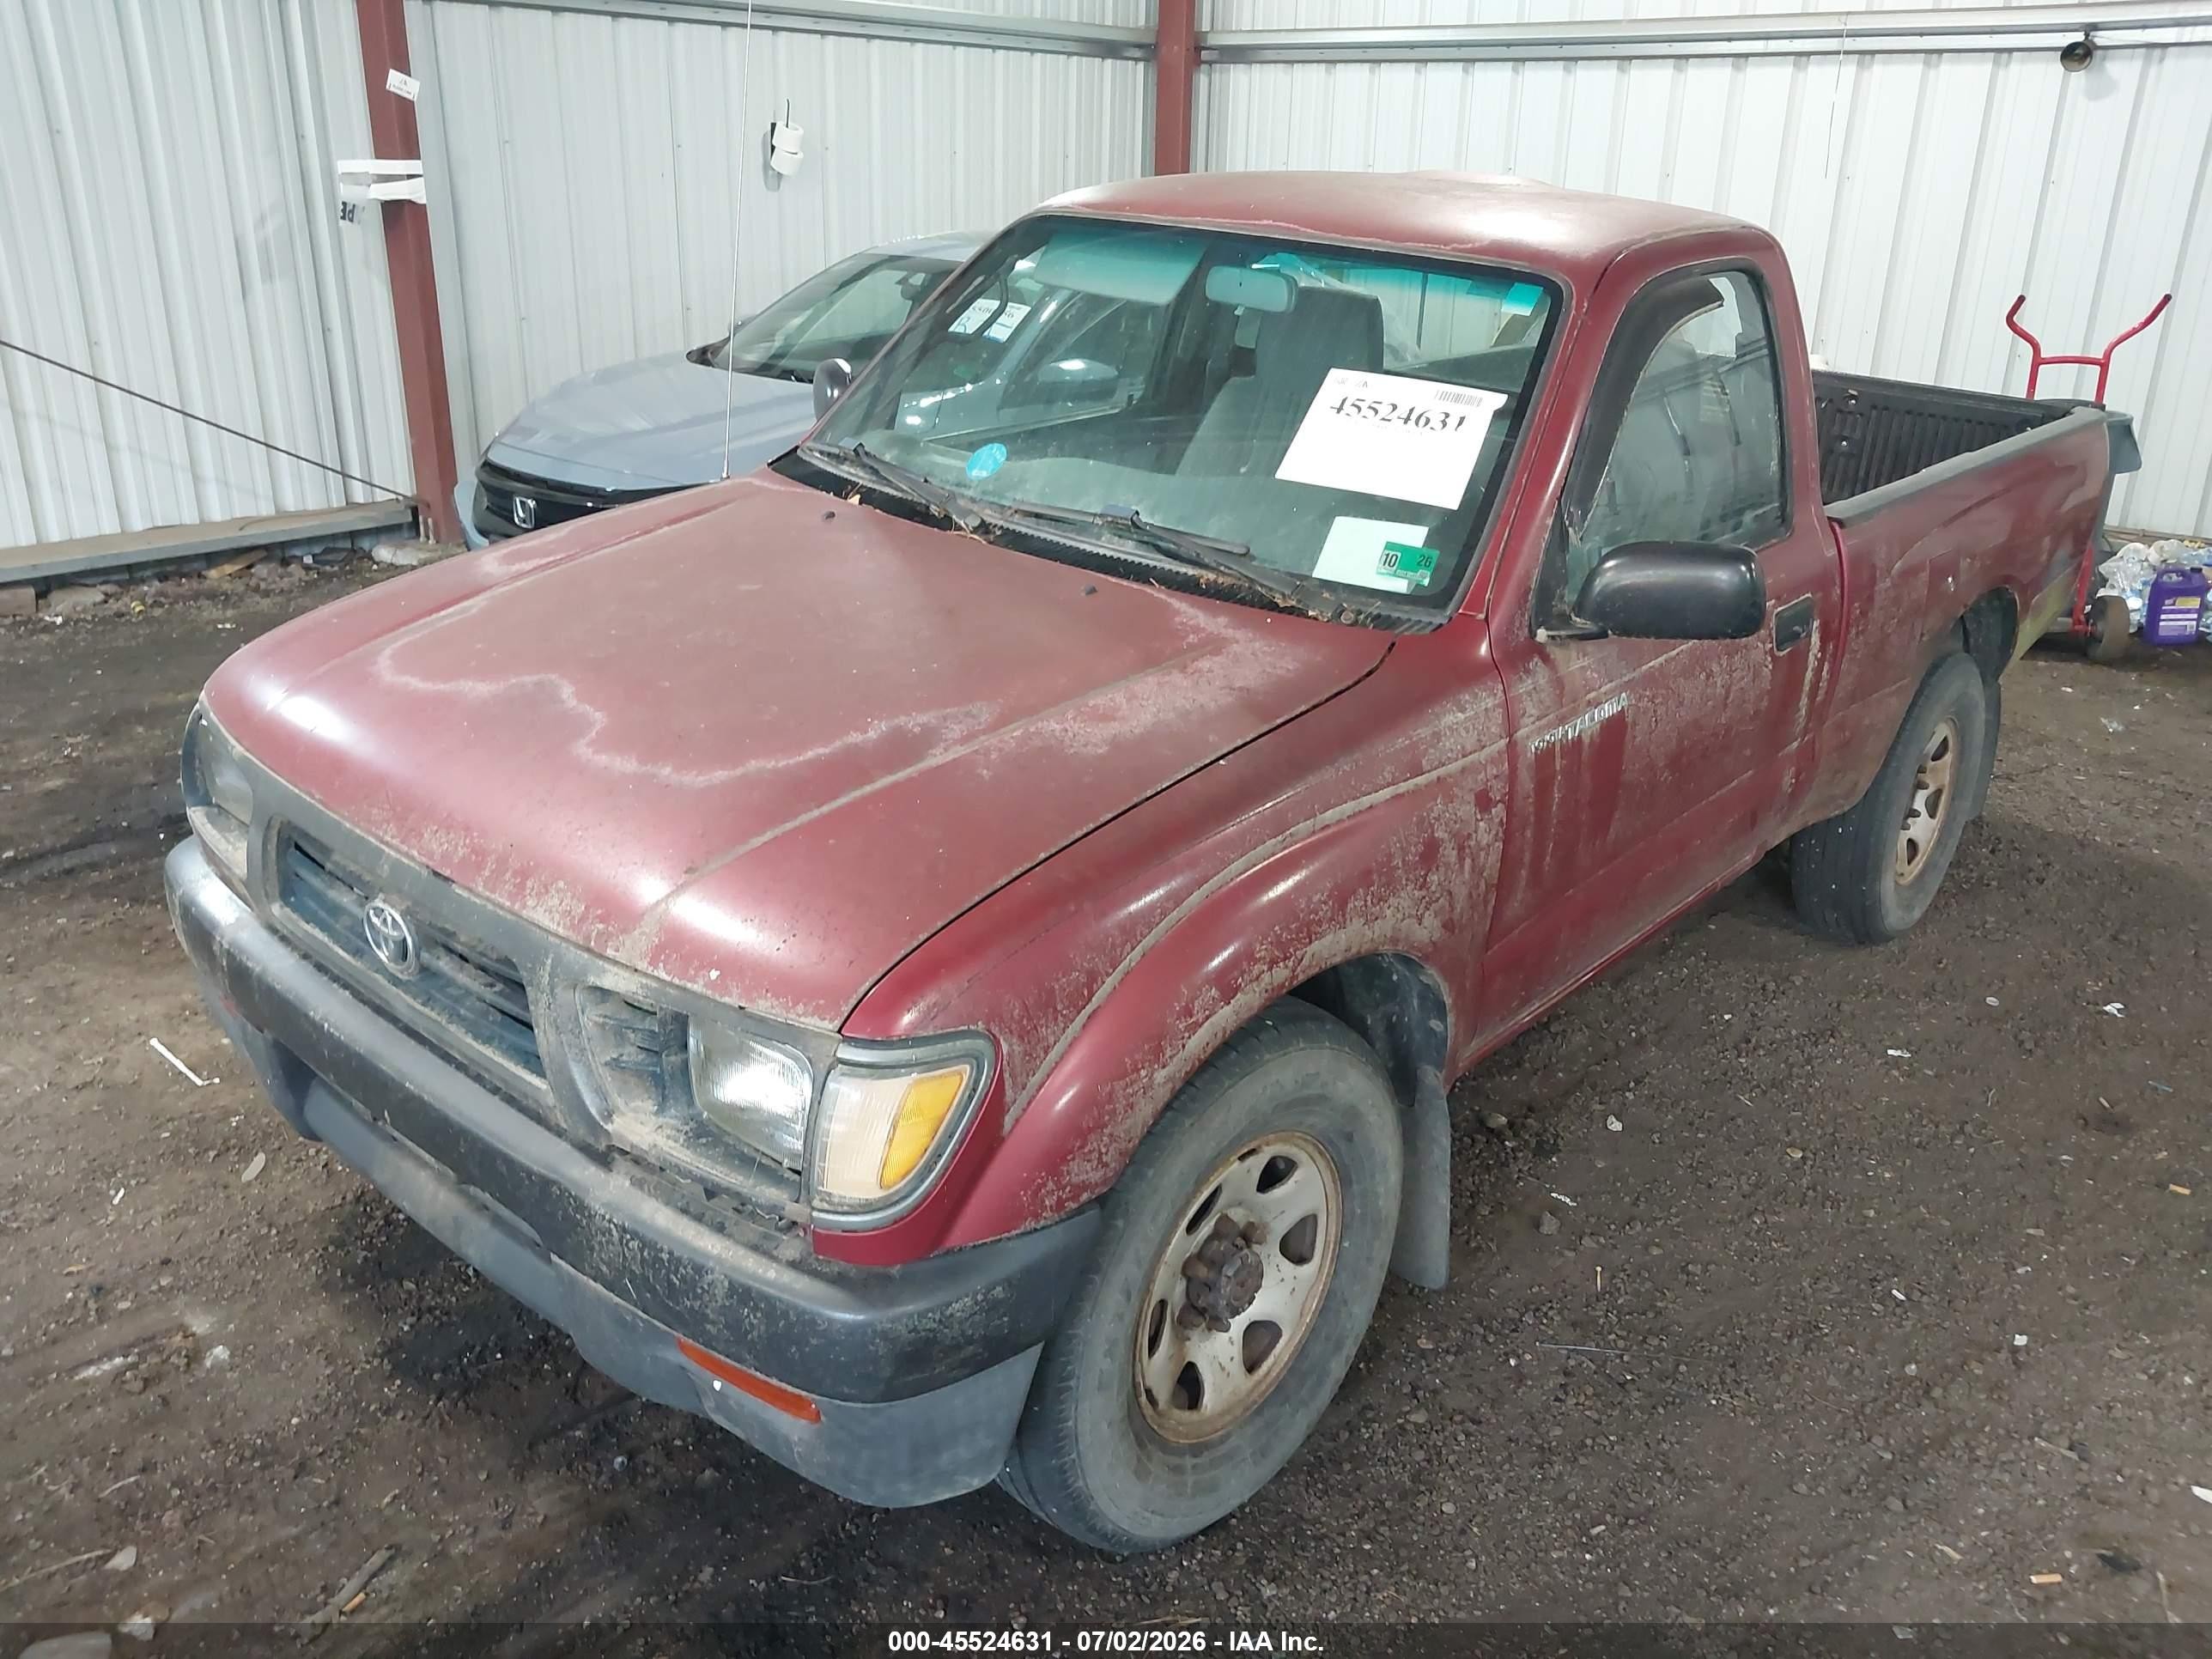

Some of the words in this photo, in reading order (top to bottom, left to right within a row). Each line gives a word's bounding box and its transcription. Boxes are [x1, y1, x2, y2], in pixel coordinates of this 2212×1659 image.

[1329, 395, 1467, 431] 45524631
[1382, 552, 1399, 568] 10
[1417, 554, 1432, 568] 26
